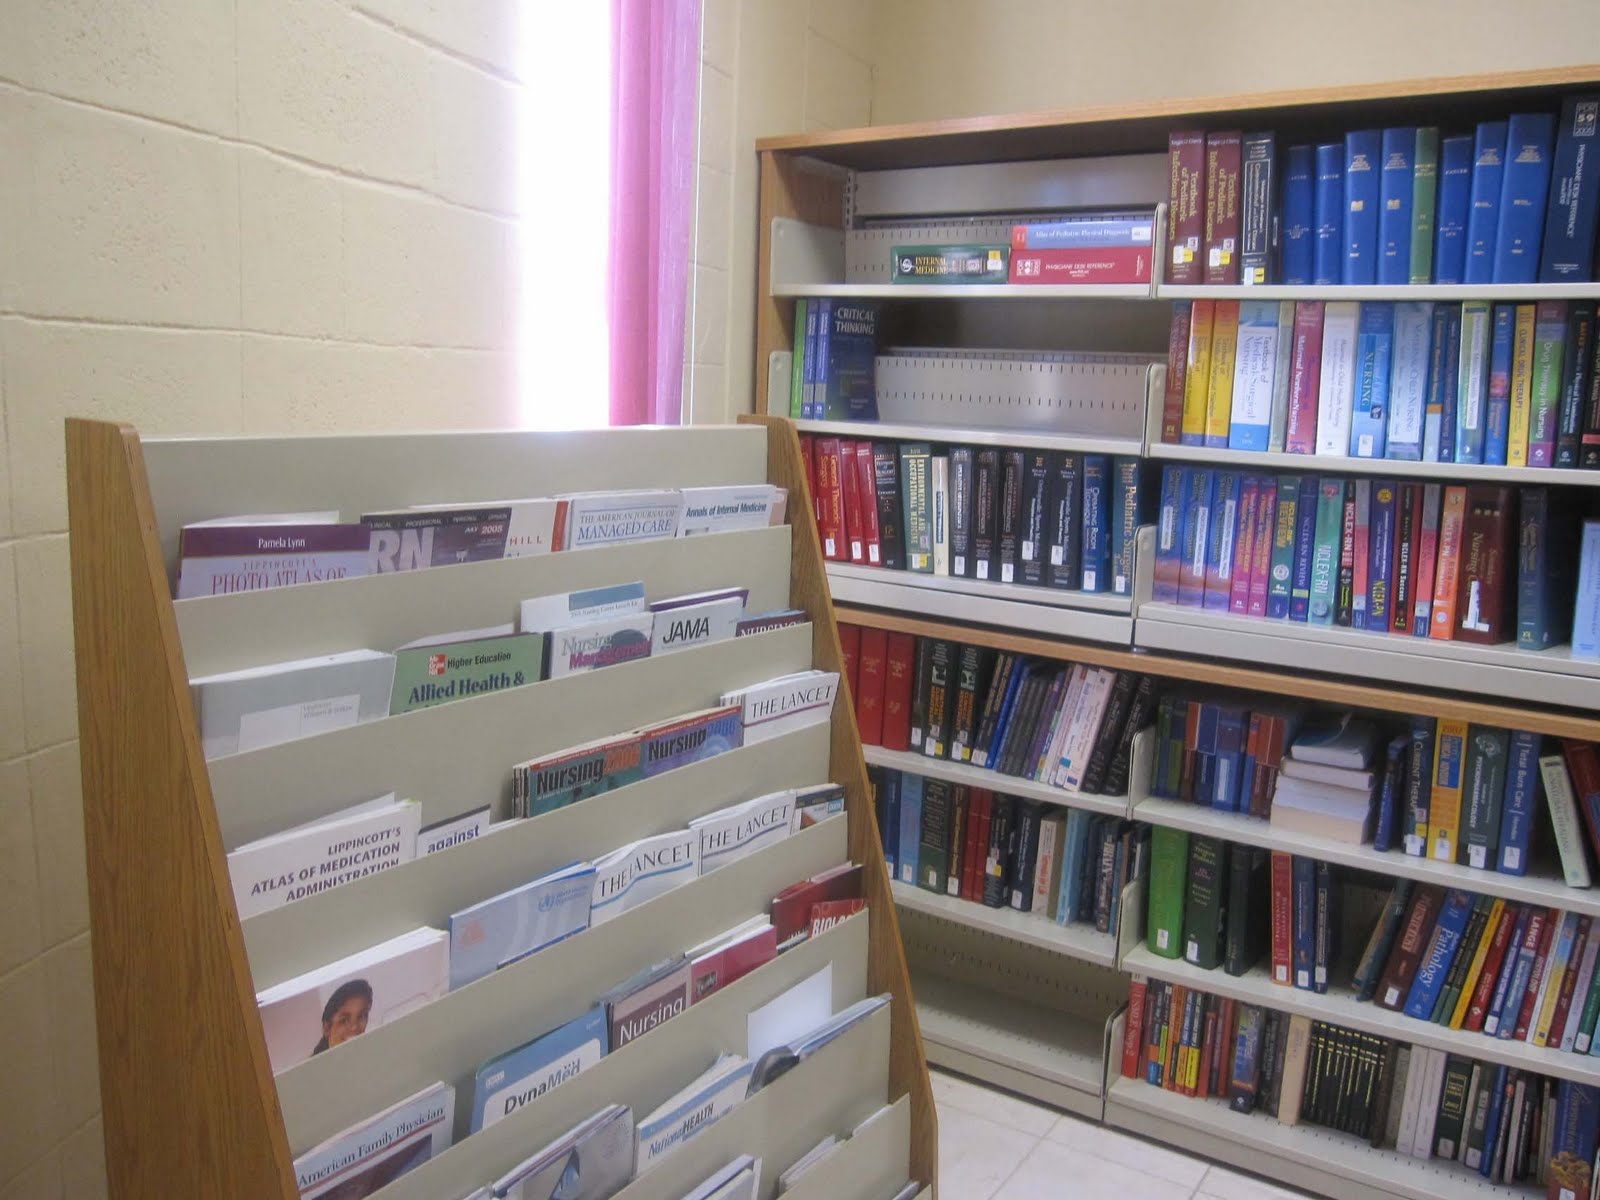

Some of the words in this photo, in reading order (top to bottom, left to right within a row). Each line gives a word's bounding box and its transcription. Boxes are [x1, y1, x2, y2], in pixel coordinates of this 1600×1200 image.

[1171, 150, 1180, 197] Infectious
[1181, 167, 1188, 178] of
[1208, 151, 1217, 199] Infectious
[1218, 168, 1226, 179] of
[1178, 180, 1189, 222] Pediatric
[1189, 171, 1199, 217] Textbook
[1217, 180, 1227, 224] Pediatric
[1227, 172, 1237, 218] Textbook
[1169, 200, 1179, 241] Diseases
[1206, 201, 1216, 242] Diseases
[915, 257, 947, 266] INTERNAL
[835, 321, 875, 334] THINKING
[837, 307, 875, 321] CRITICAL
[1240, 335, 1253, 375] Nursing
[1261, 336, 1272, 371] Textbook
[1295, 335, 1306, 369] Maternal
[1518, 329, 1526, 358] CLINICAL
[1541, 343, 1553, 362] Drug
[1261, 374, 1269, 383] of
[1361, 351, 1374, 406] NURSING
[1516, 380, 1524, 408] THERAPY
[1538, 365, 1550, 396] Therapy
[1540, 398, 1548, 406] in
[1535, 407, 1547, 439] Nursing
[820, 455, 829, 488] Surgery
[830, 454, 839, 485] General
[909, 458, 918, 508] OCCUPATIONAL
[916, 458, 925, 515] ENVIRONMENTAL
[405, 518, 442, 527] PROFESSIONAL
[581, 514, 595, 524] THE
[596, 511, 633, 522] AMERICAN
[633, 510, 666, 521] JOURNAL
[665, 509, 675, 518] OF
[686, 506, 708, 518] Annals
[708, 506, 716, 516] of
[717, 503, 740, 515] Internal
[740, 502, 767, 514] Medicine
[830, 489, 840, 524] Thoracic
[1091, 487, 1100, 526] OPERATING
[1123, 485, 1136, 537] Pediatric
[480, 525, 503, 535] 2005
[577, 521, 640, 541] MANAGED
[642, 519, 673, 533] CARE
[909, 511, 918, 544] MEDICINE
[917, 517, 926, 531] AND
[1090, 527, 1099, 549] ROOM
[1277, 501, 1288, 547] REVIEW
[1301, 516, 1311, 556] NCLEX-RN
[1343, 501, 1355, 551] NCLEX-RN
[258, 537, 286, 549] Pamela
[287, 537, 306, 550] Lynn
[368, 527, 435, 574] RN
[509, 536, 542, 546] HILL
[1466, 532, 1484, 573] Nursing
[243, 558, 317, 571] LIPPINCOTT'S
[1298, 558, 1308, 586] REVIEW
[1315, 545, 1332, 594] NCLEX-RN
[1400, 542, 1409, 574] NCLEX-RN
[211, 573, 269, 596] PHOTO
[274, 569, 322, 587] ATLAS
[326, 567, 347, 581] OF
[1398, 575, 1406, 601] Success
[562, 632, 613, 656] Nursing
[662, 617, 710, 644] JAMA
[447, 657, 472, 669] Higher
[474, 651, 511, 664] Education
[569, 640, 652, 670] Management
[408, 680, 455, 704] Allied
[459, 672, 510, 695] Health
[513, 671, 525, 685] &
[751, 702, 777, 718] THE
[781, 685, 832, 710] LANCET
[1411, 740, 1424, 777] CURRENT
[1518, 748, 1530, 768] Total
[536, 756, 604, 795] Nursing
[1469, 756, 1483, 828] PSYCHOPHARMACOLOGY
[1516, 770, 1527, 788] Burn
[1409, 780, 1421, 814] THERAPY
[1513, 790, 1524, 808] Care
[328, 826, 401, 856] LIPPINCOTT'S
[427, 824, 480, 854] against
[702, 828, 733, 852] THE
[736, 805, 790, 841] LANCET
[250, 872, 294, 896] ATLAS
[298, 867, 317, 881] OF
[319, 842, 400, 876] MEDICATION
[285, 857, 400, 902] ADMINISTRATION
[600, 873, 628, 897] THE
[627, 840, 693, 879] LANCET
[1525, 915, 1542, 948] LANGE
[1419, 927, 1454, 988] Pathology
[1528, 956, 1545, 994] HISTOLOGY
[620, 996, 684, 1046] Nursing
[299, 1152, 356, 1187] American
[358, 1132, 394, 1157] Family
[396, 1107, 445, 1139] Physician
